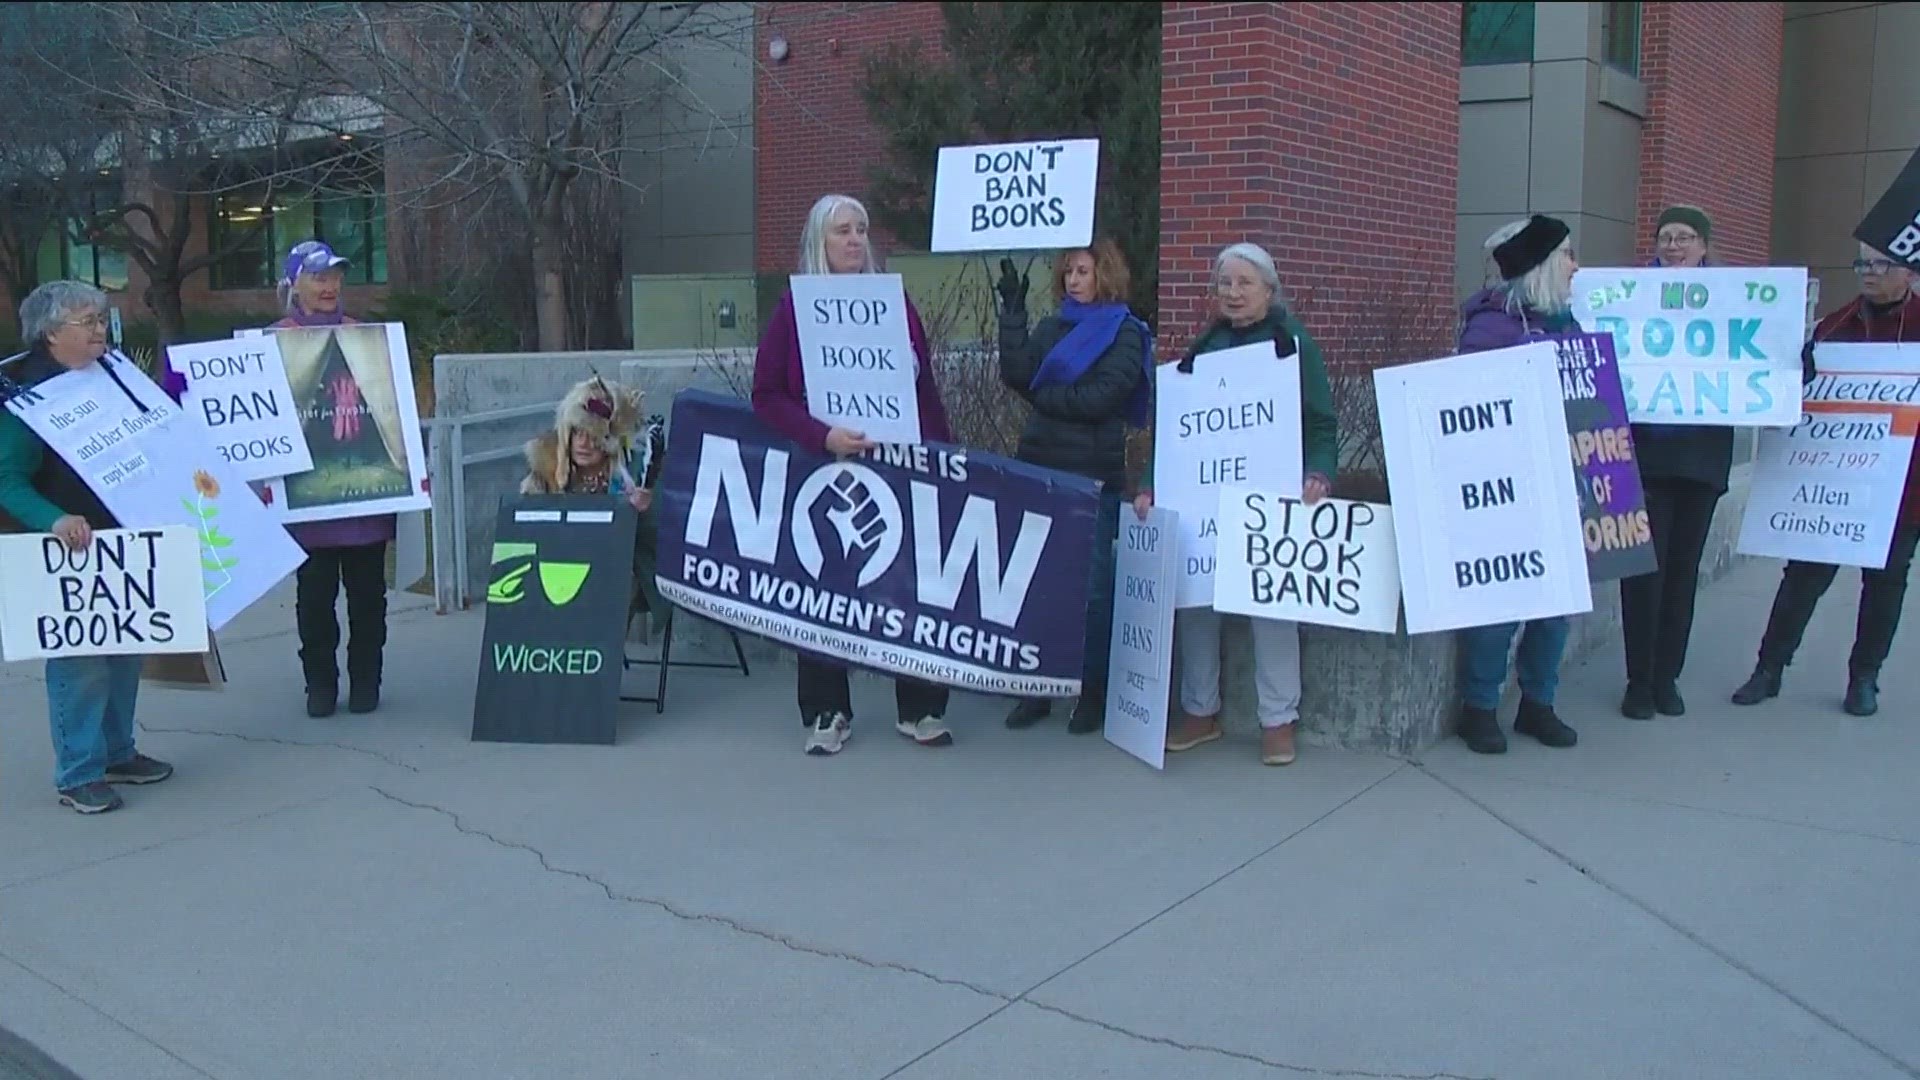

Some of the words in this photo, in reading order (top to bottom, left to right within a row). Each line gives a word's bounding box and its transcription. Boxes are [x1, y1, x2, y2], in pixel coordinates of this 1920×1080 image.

[974, 145, 1064, 173] DON'T
[986, 173, 1046, 202] BAN
[972, 197, 1065, 232] BOOKS
[1589, 280, 1637, 310] SAY
[1660, 281, 1709, 310] NO
[1745, 281, 1778, 303] TO
[814, 298, 887, 325] STOP
[1595, 317, 1767, 361] BOOK
[189, 352, 265, 380] DON'T
[821, 345, 896, 370] BOOK
[1218, 377, 1227, 389] A
[1562, 368, 1597, 399] AAS
[50, 411, 76, 430] the
[75, 399, 100, 419] sun
[202, 390, 279, 426] BAN
[826, 391, 901, 420] BANS
[1179, 398, 1274, 438] STOLEN
[1439, 398, 1514, 436] DON'T
[77, 436, 104, 460] and
[98, 426, 124, 447] her
[121, 404, 169, 436] flowers
[1789, 413, 1888, 439] Poems
[102, 465, 123, 486] rupi
[121, 453, 145, 472] kaur
[861, 443, 929, 473] IME
[939, 450, 967, 482] IS
[1200, 456, 1247, 485] LIFE
[1788, 450, 1880, 469] 1947-1997
[1461, 477, 1516, 510] BAN
[1592, 474, 1613, 505] OF
[1792, 484, 1850, 507] Allen
[685, 433, 1052, 628] NOW
[1198, 518, 1218, 538] JA
[1244, 494, 1374, 542] STOP
[1583, 510, 1650, 552] ORMS
[1770, 511, 1866, 542] Ginsberg
[42, 531, 163, 574] DON'T
[1128, 524, 1159, 552] STOP
[1187, 556, 1217, 576] DU
[1246, 533, 1364, 578] BOOK
[1455, 549, 1545, 588] BOOKS
[60, 569, 156, 612] BAN
[1125, 575, 1156, 604] BOOK
[1251, 567, 1360, 615] BANS
[683, 553, 740, 594] FOR
[750, 567, 905, 638] WOMEN'S
[913, 614, 1040, 670] RIGHTS
[37, 610, 174, 650] BOOKS
[661, 583, 707, 610] NATIONAL
[710, 604, 792, 636] ORGANIZATION
[794, 627, 817, 643] FOR
[820, 634, 868, 657] WOMEN
[881, 650, 959, 680] SOUTHWEST
[962, 671, 1006, 690] IDAHO
[1010, 680, 1073, 694] CHAPTER
[1122, 623, 1153, 653] BANS
[494, 642, 603, 674] WICKED
